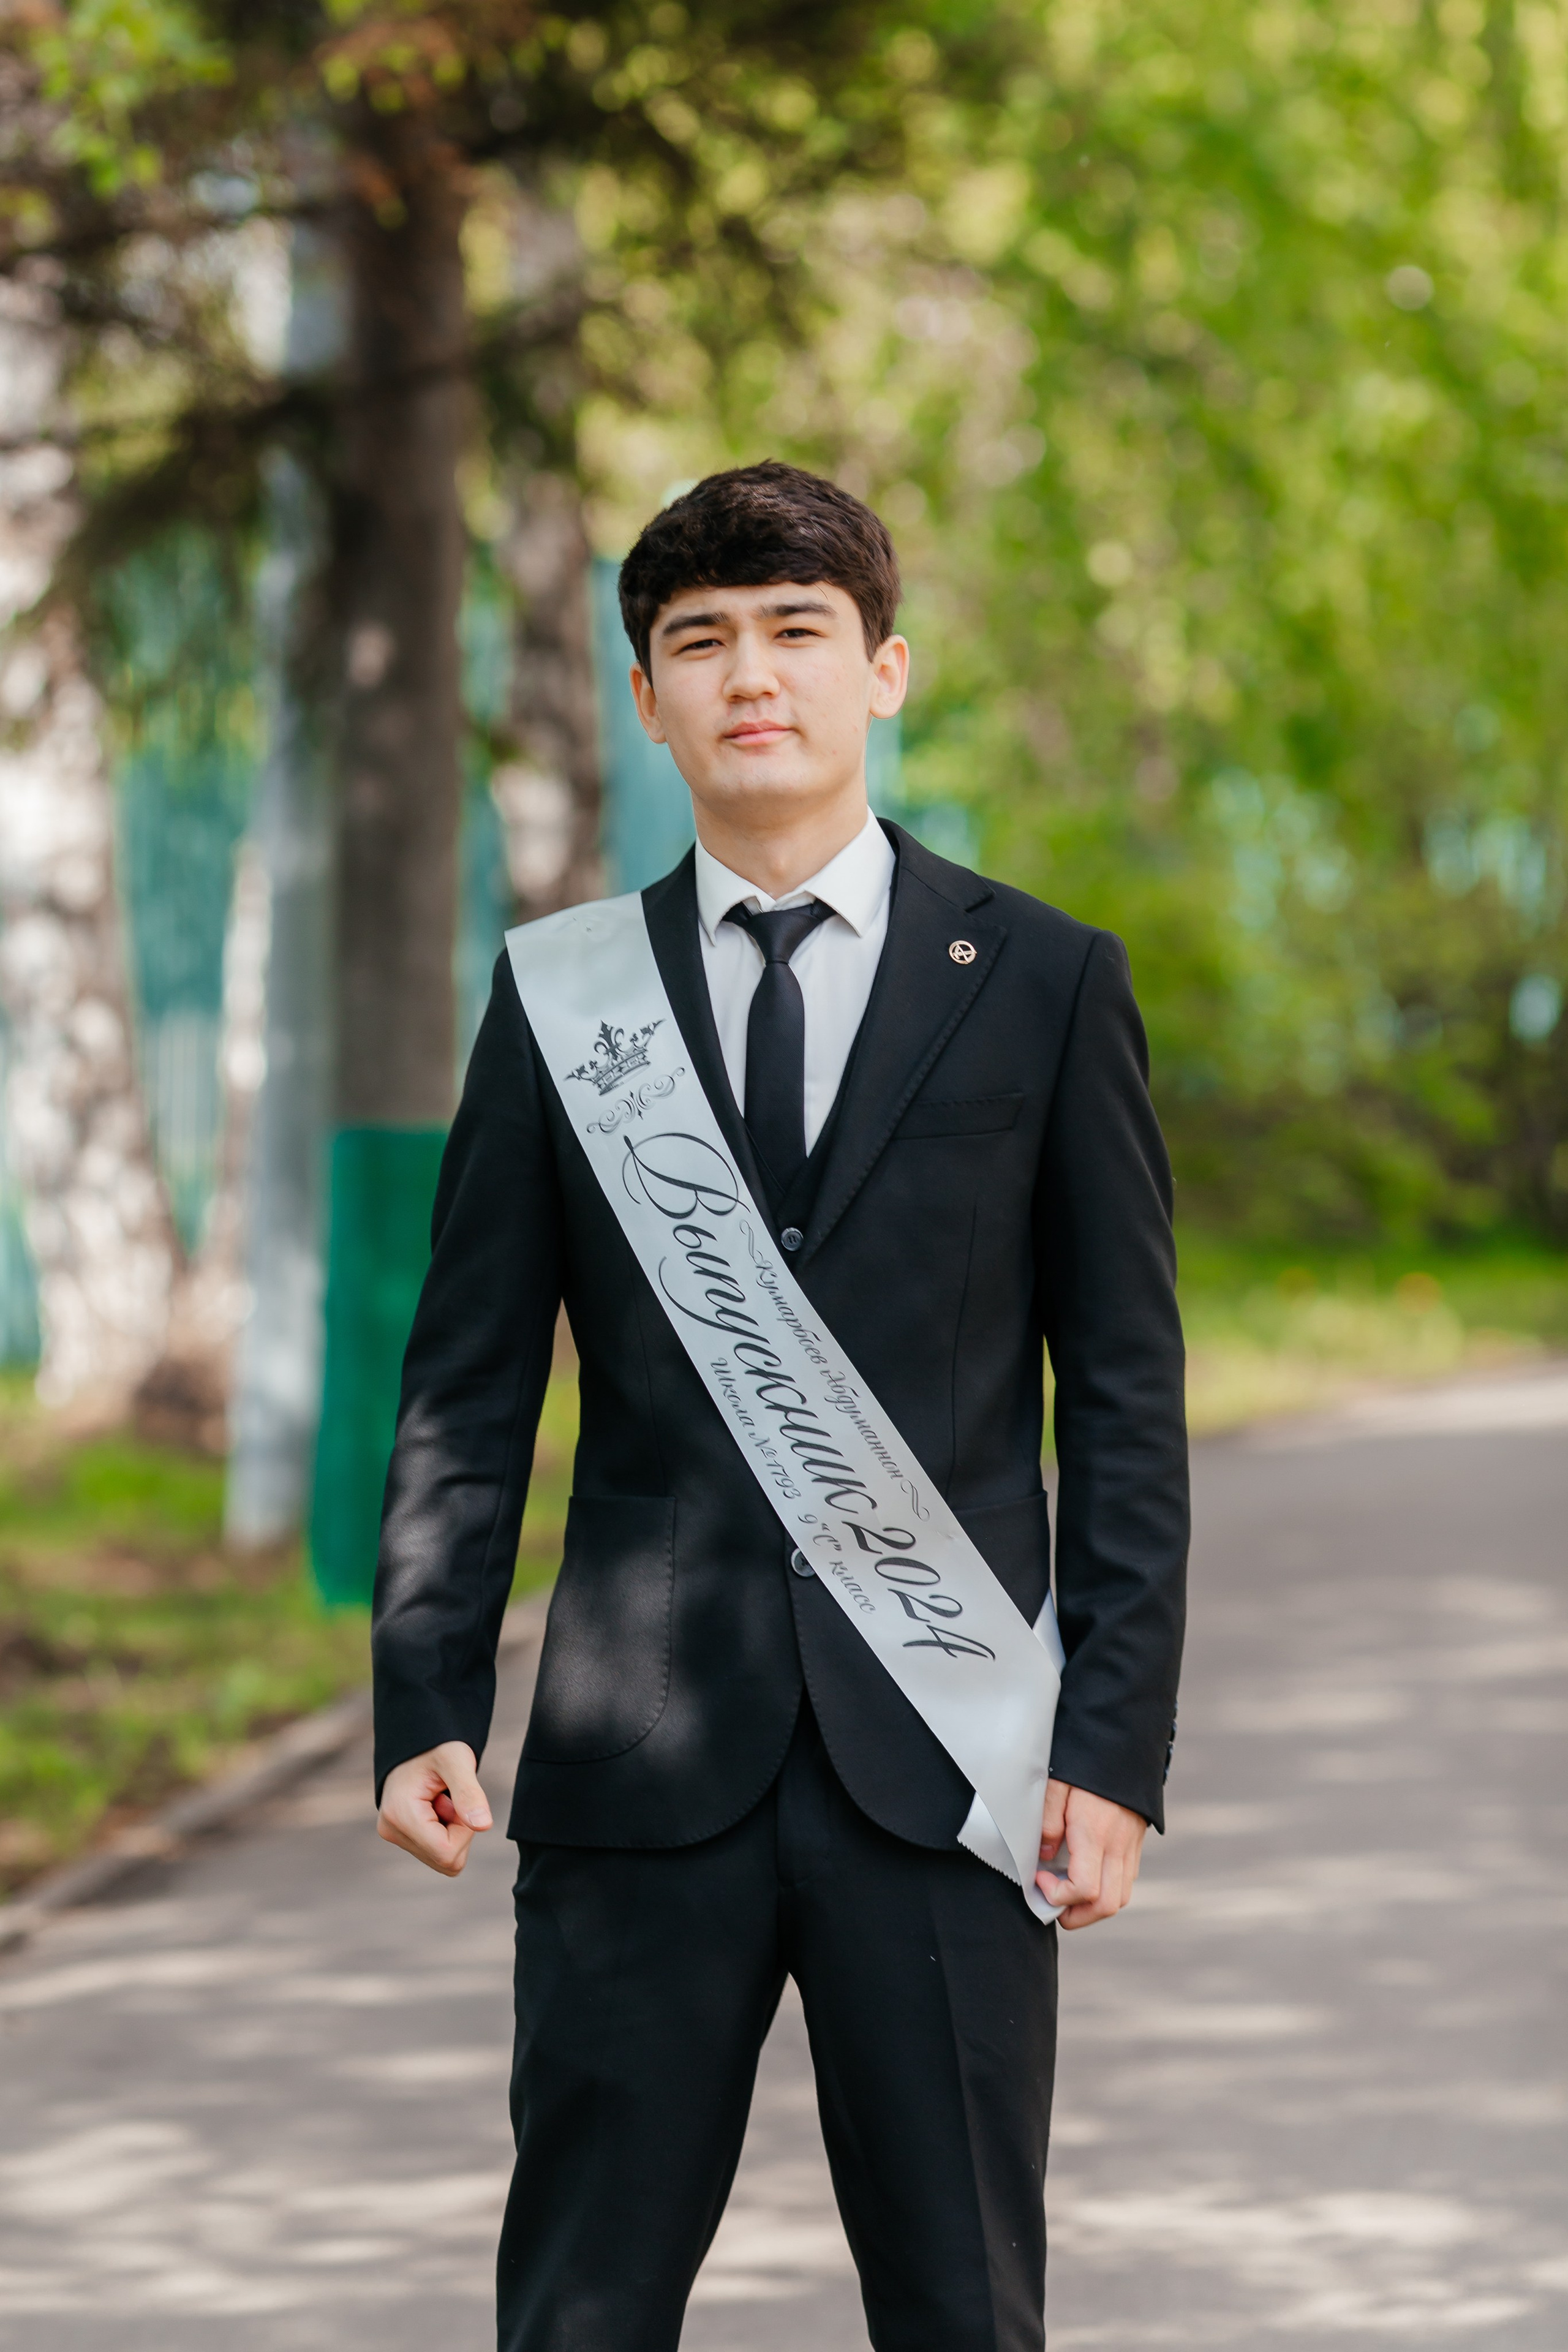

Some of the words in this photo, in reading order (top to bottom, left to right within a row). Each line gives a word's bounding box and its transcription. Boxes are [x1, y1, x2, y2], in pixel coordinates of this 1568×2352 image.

[622, 1132, 878, 1514] Выпускник
[841, 1520, 996, 1662] 2024
[710, 1357, 755, 1428] Школа
[829, 1561, 876, 1615] класс
[756, 1259, 827, 1363] Кумарбоев
[820, 1370, 904, 1479] Абдуманнон
